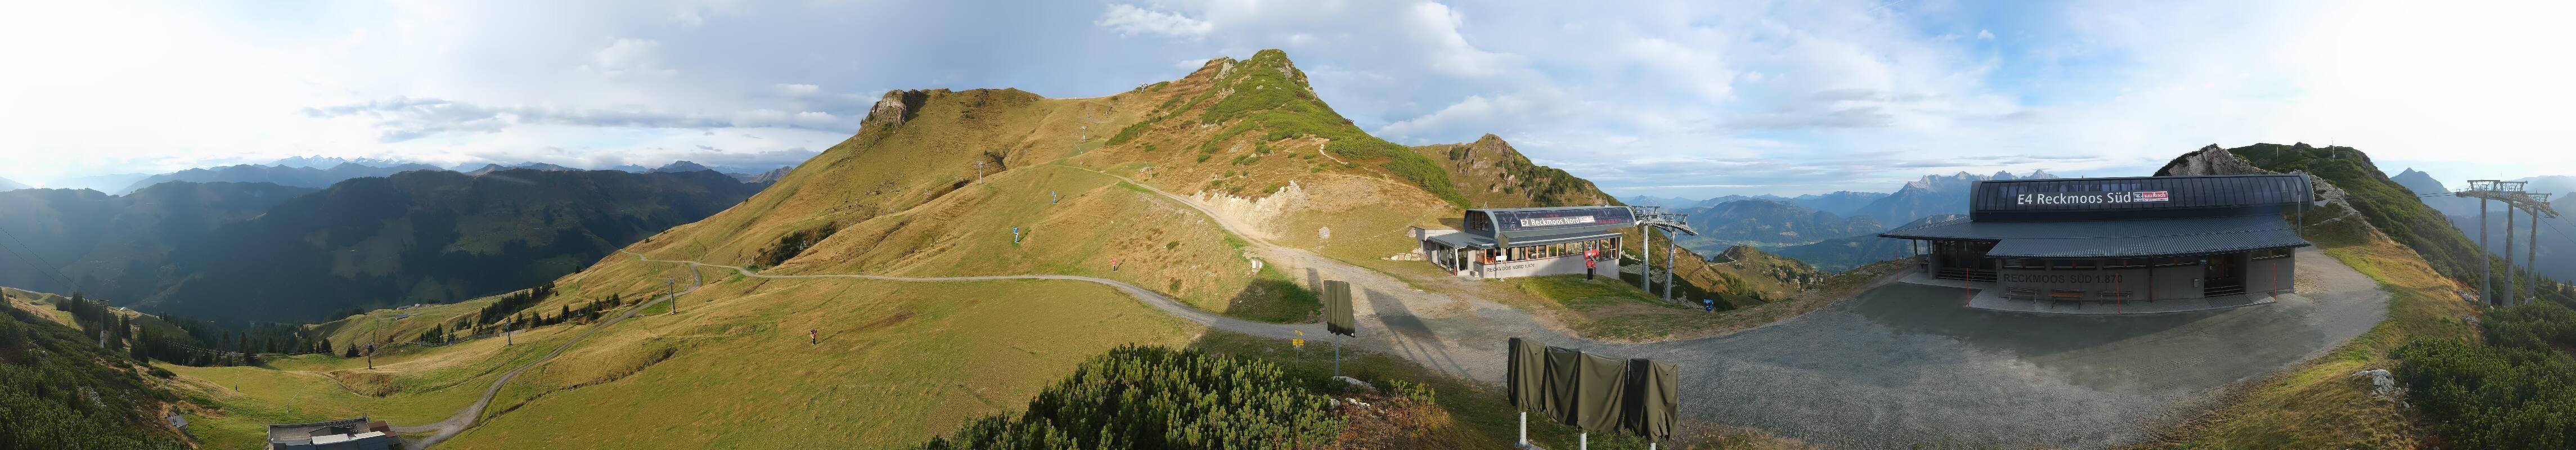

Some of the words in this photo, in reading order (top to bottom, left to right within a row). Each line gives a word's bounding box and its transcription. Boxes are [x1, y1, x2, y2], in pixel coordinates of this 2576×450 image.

[2017, 194, 2033, 205] E4
[2037, 193, 2103, 204] Reckmoos
[2107, 192, 2131, 203] Süd
[2003, 273, 2065, 284] RECKMOOS
[2070, 273, 2092, 284] SÜD
[2096, 274, 2123, 284] 1.870
